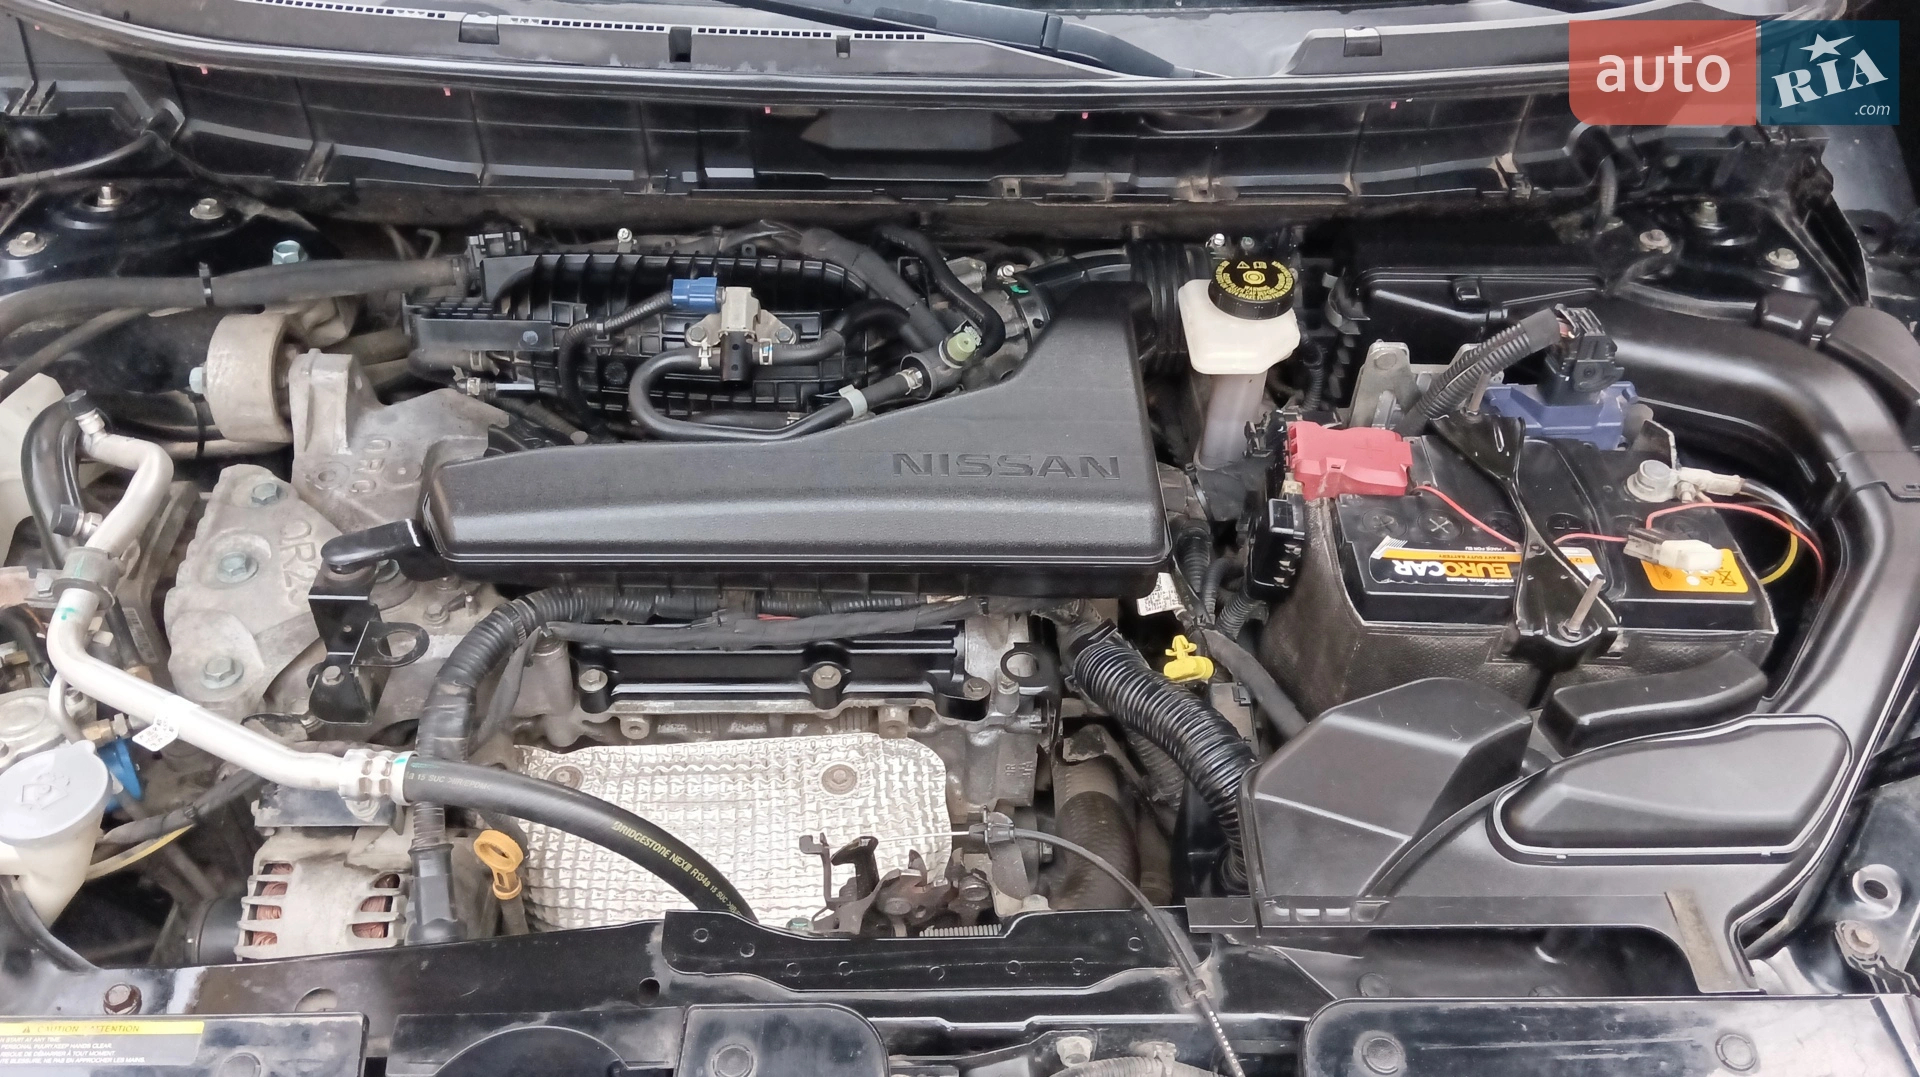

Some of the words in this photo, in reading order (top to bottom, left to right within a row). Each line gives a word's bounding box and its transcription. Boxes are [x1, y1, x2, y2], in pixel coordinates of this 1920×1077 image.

[892, 453, 1121, 480] NISSAN
[1392, 560, 1512, 578] EUROCAR
[428, 774, 446, 783] SUC
[611, 821, 672, 858] BRIDGESTONE
[710, 885, 718, 893] 15
[716, 891, 728, 903] SUC
